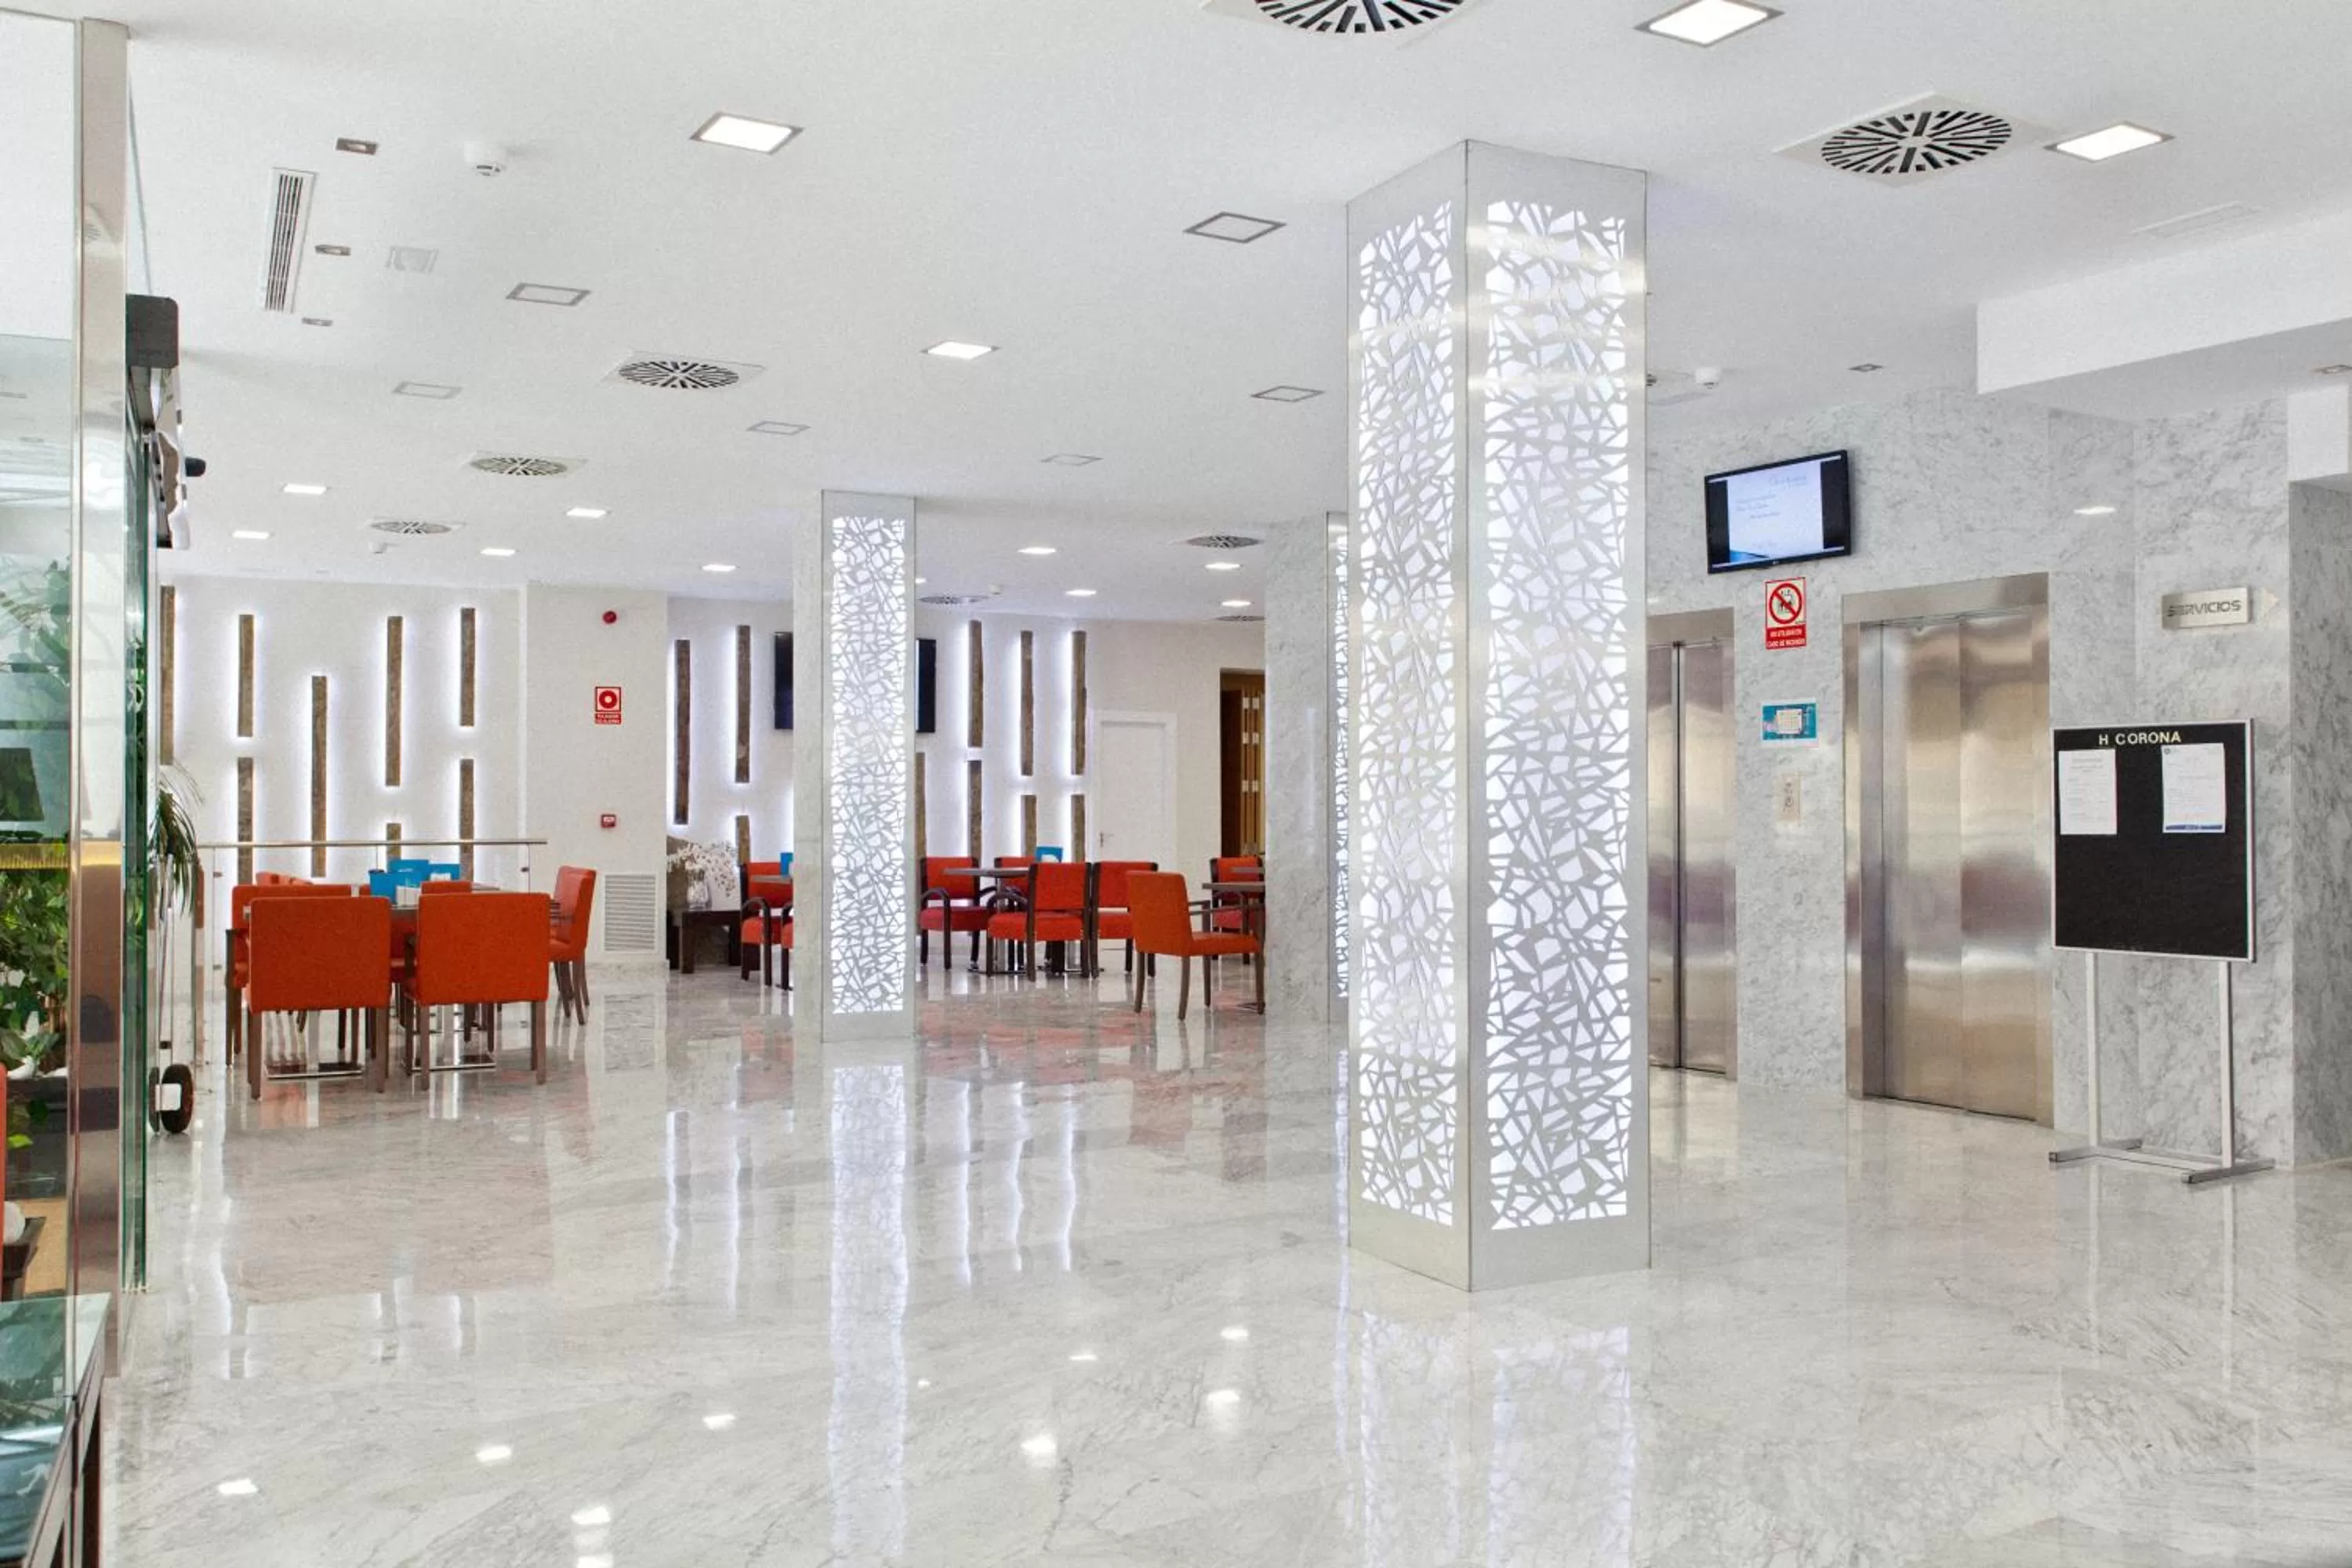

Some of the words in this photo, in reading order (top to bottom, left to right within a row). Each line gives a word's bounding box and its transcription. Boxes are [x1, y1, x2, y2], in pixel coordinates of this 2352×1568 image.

[2167, 600, 2241, 617] SERVICIOS
[2099, 733, 2108, 746] H
[2114, 731, 2182, 746] CORONA
